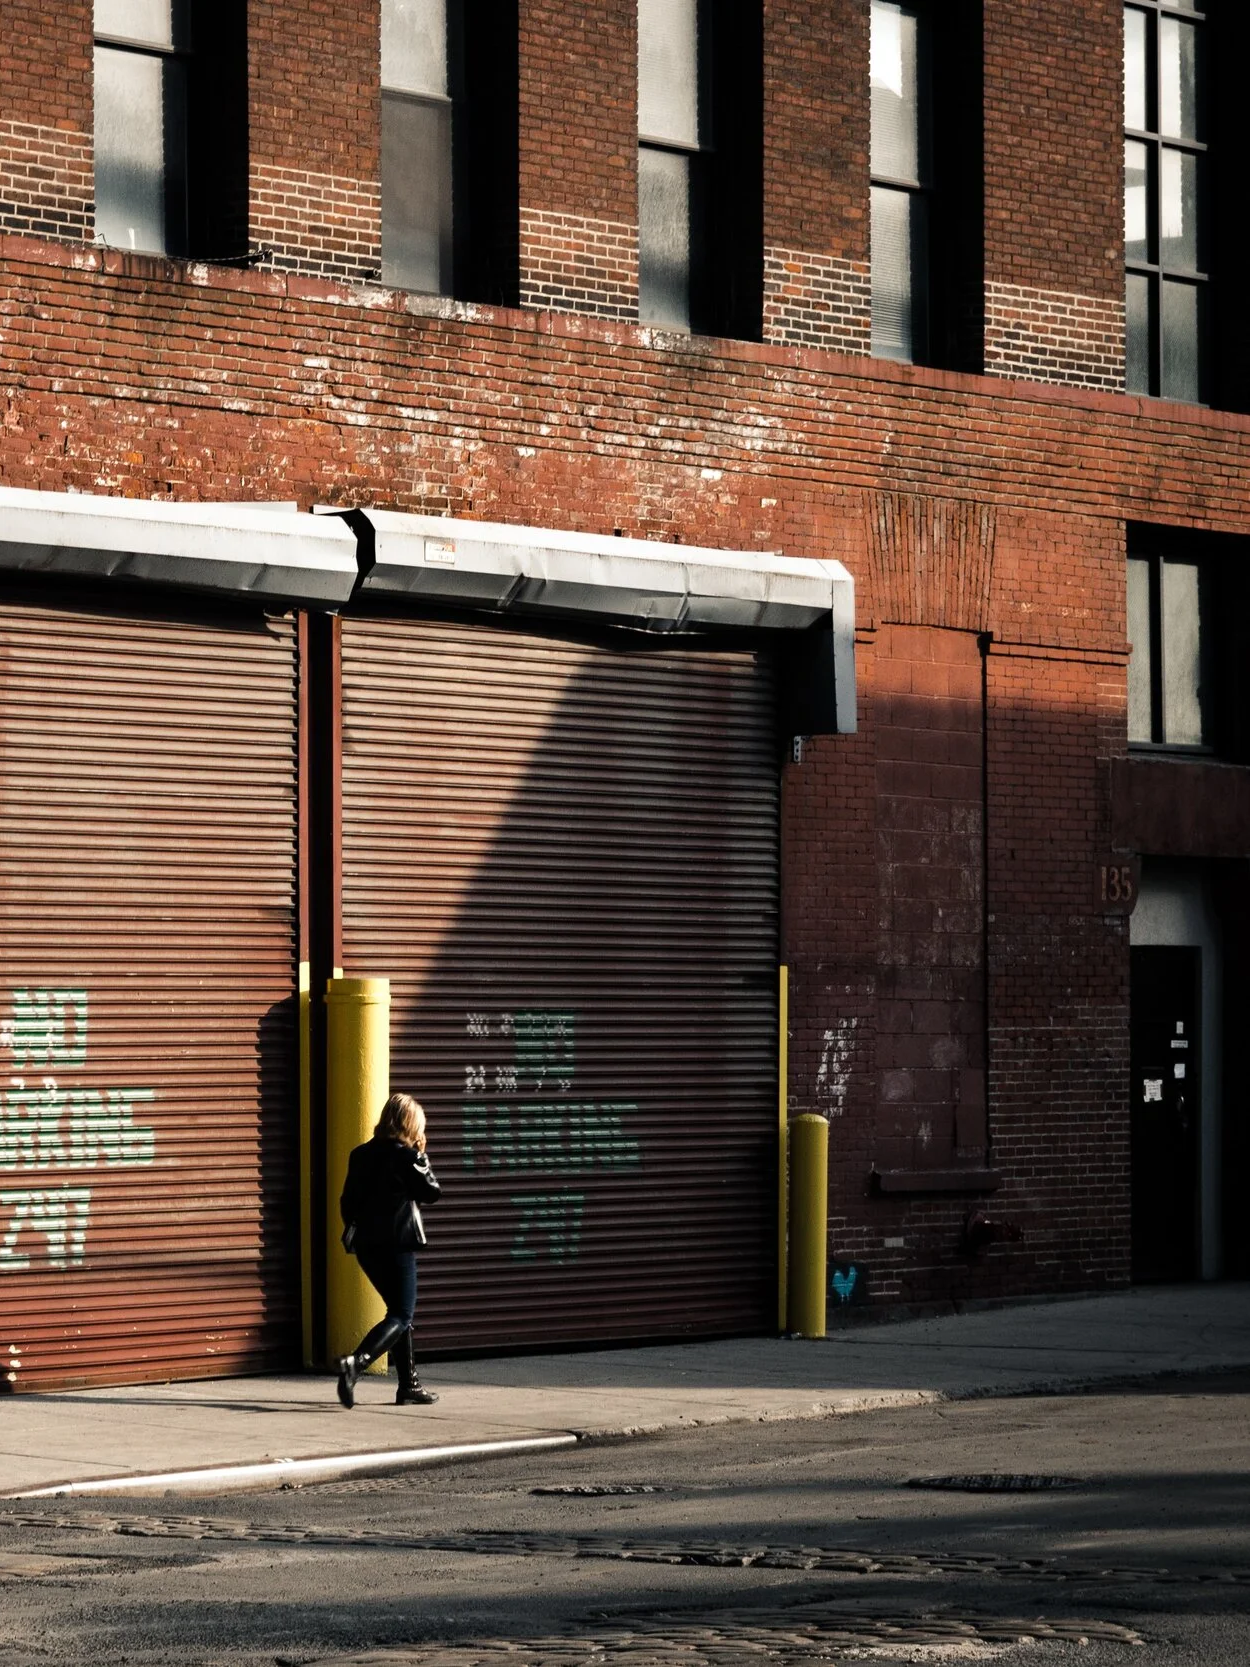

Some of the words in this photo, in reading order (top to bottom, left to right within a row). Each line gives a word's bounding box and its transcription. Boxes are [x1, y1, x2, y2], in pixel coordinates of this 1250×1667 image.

[1101, 866, 1132, 901] 135
[12, 987, 88, 1067] NO
[514, 1008, 575, 1076] NO
[461, 1101, 640, 1174] PARKING
